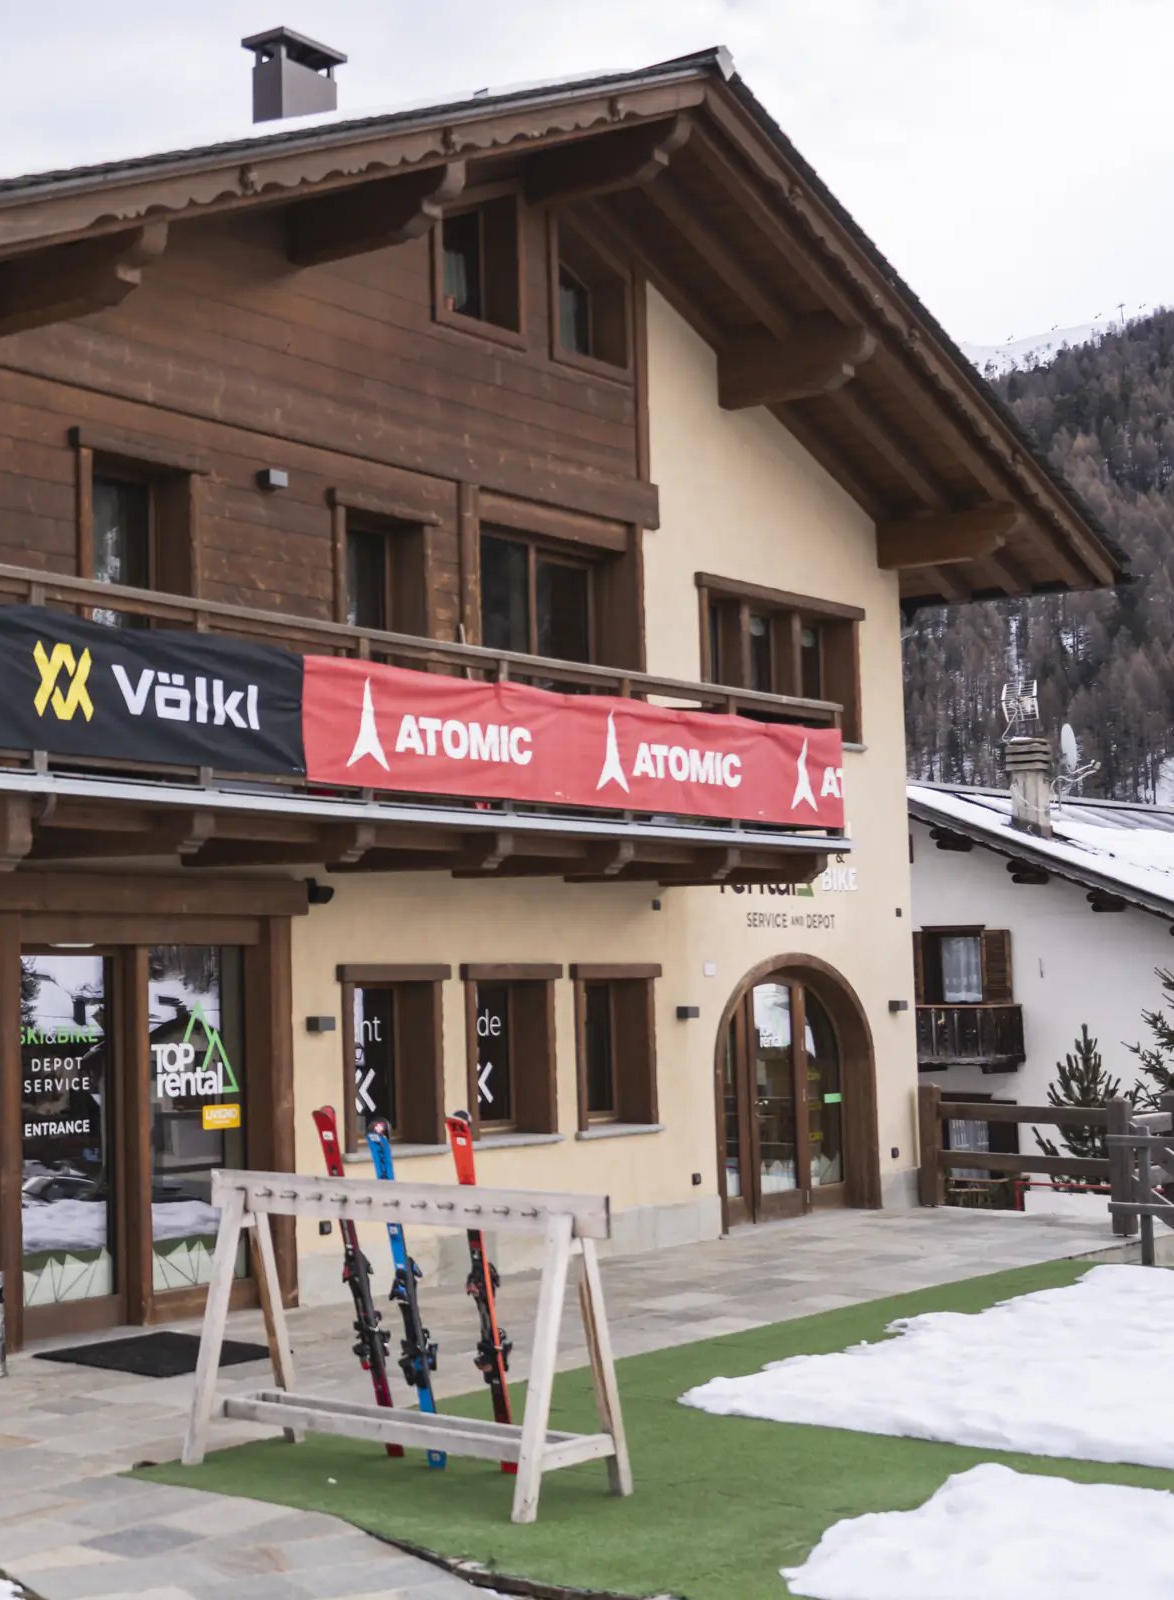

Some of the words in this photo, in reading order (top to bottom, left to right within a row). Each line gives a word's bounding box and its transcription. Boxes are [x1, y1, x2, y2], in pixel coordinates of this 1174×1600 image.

[111, 664, 260, 730] Völkl
[395, 714, 532, 765] ATOMIC
[632, 742, 742, 788] ATOMIC
[822, 867, 858, 891] BIKE
[746, 912, 788, 929] SERVICE
[806, 914, 835, 929] DEPOT
[31, 1057, 83, 1072] DEPOT
[151, 1042, 195, 1073] TOP
[24, 1077, 90, 1094] SERVICE
[157, 1062, 223, 1098] rental
[24, 1119, 91, 1137] ENTRANCE
